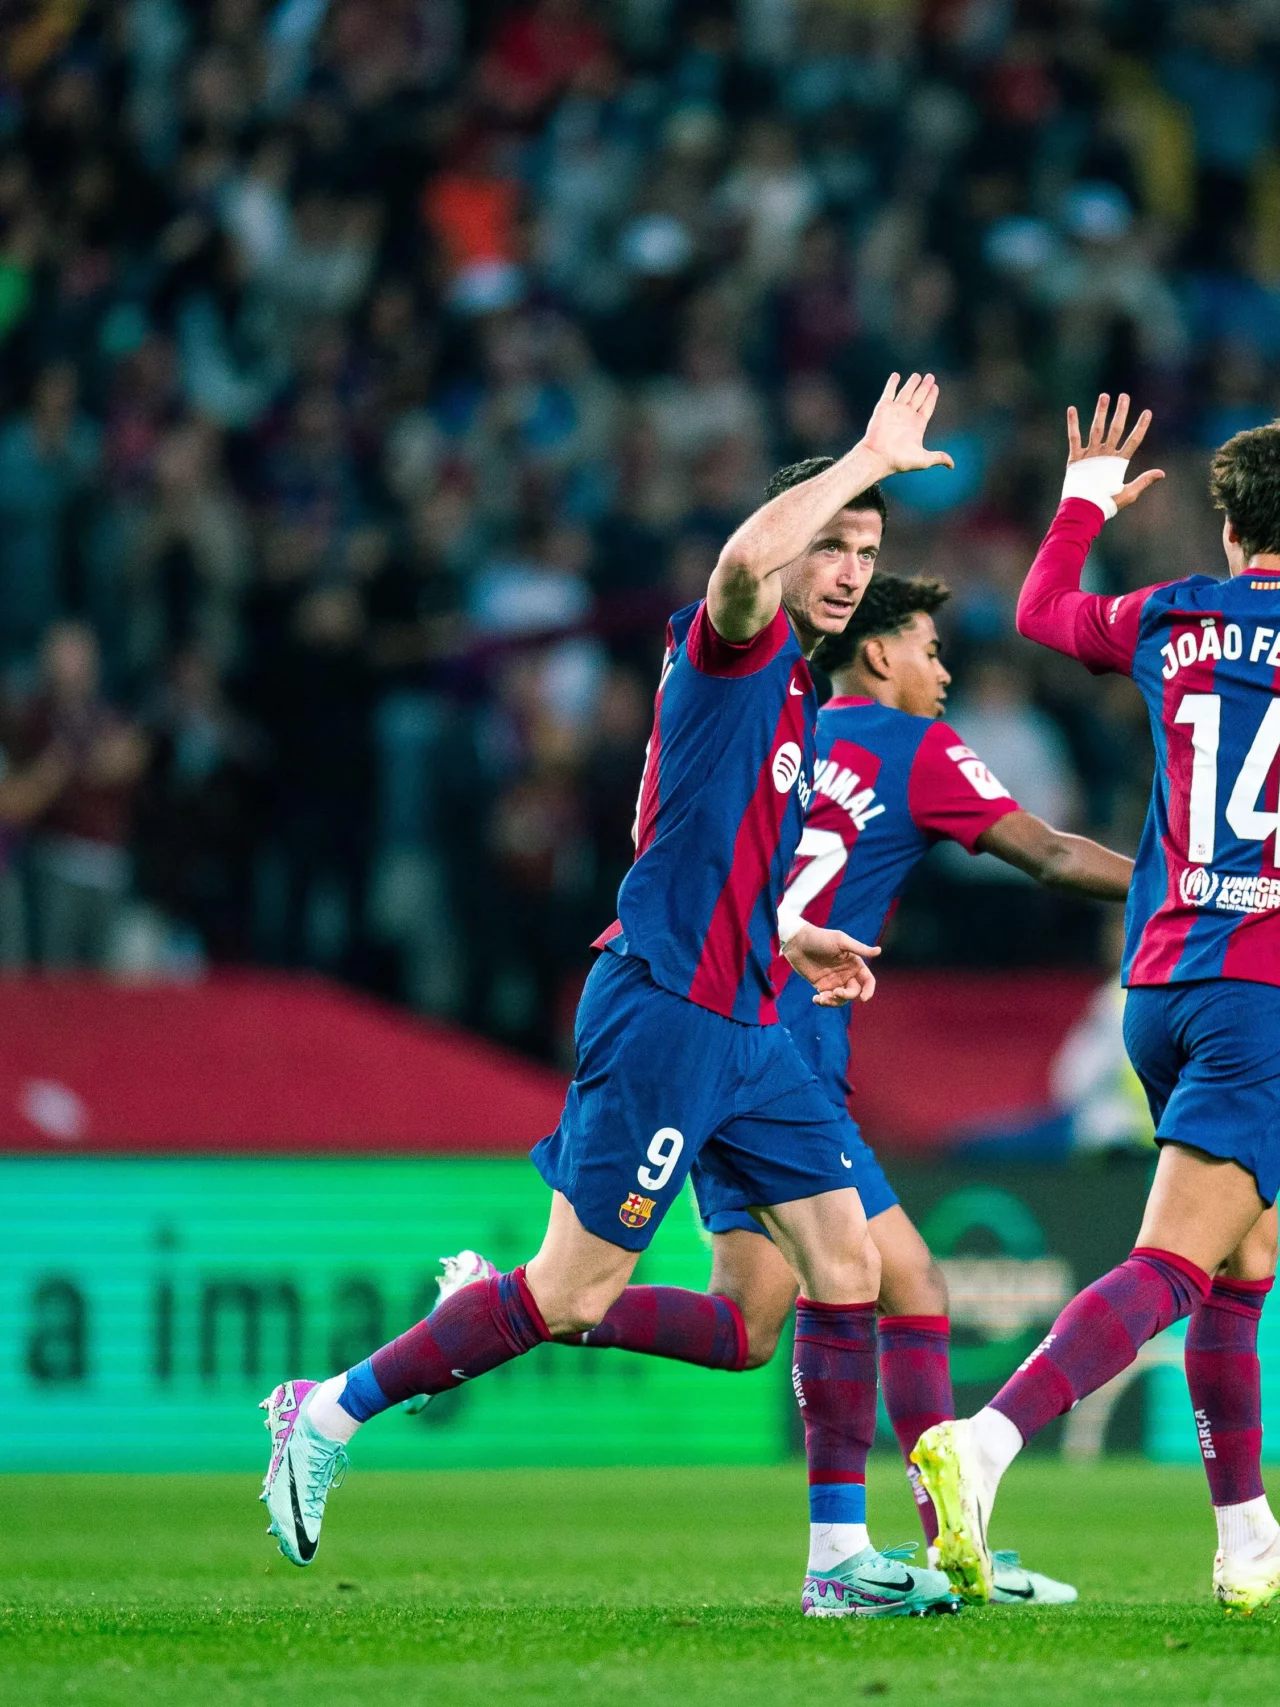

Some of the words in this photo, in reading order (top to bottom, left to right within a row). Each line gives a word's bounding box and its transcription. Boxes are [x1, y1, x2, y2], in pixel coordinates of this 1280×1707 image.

[1160, 618, 1243, 680] JOÃO
[637, 1127, 684, 1191] 9
[1194, 1408, 1216, 1459] BARÇA
